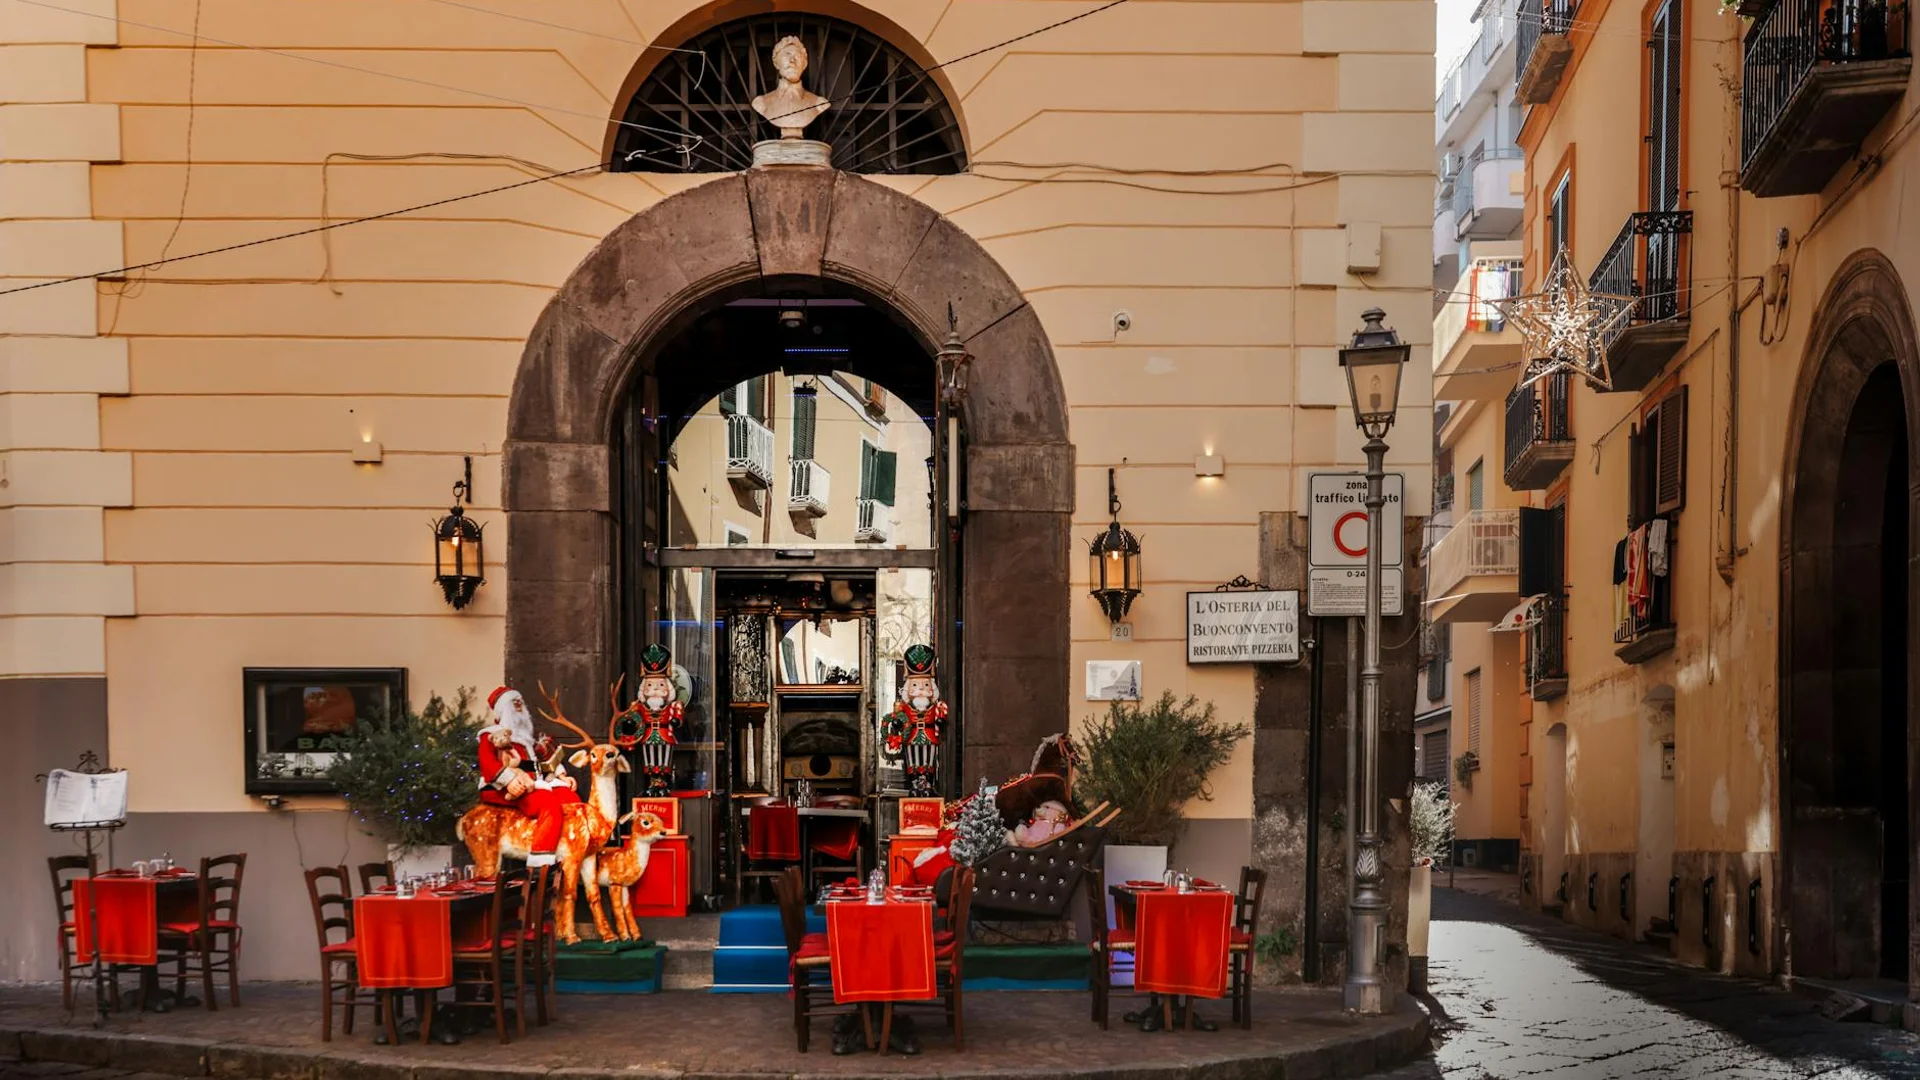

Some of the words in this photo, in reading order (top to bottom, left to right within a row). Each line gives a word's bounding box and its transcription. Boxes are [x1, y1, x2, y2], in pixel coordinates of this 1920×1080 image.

[1345, 481, 1368, 490] zona
[1315, 493, 1354, 503] traffico
[1358, 492, 1399, 503] liato
[1196, 600, 1262, 614] L'OSTERIA
[1267, 600, 1291, 612] DEL
[1115, 627, 1129, 637] 20
[1193, 622, 1294, 637] BUONCONVENTO
[1193, 645, 1249, 657] RISTORANTE
[1251, 643, 1294, 655] PIZZERIA
